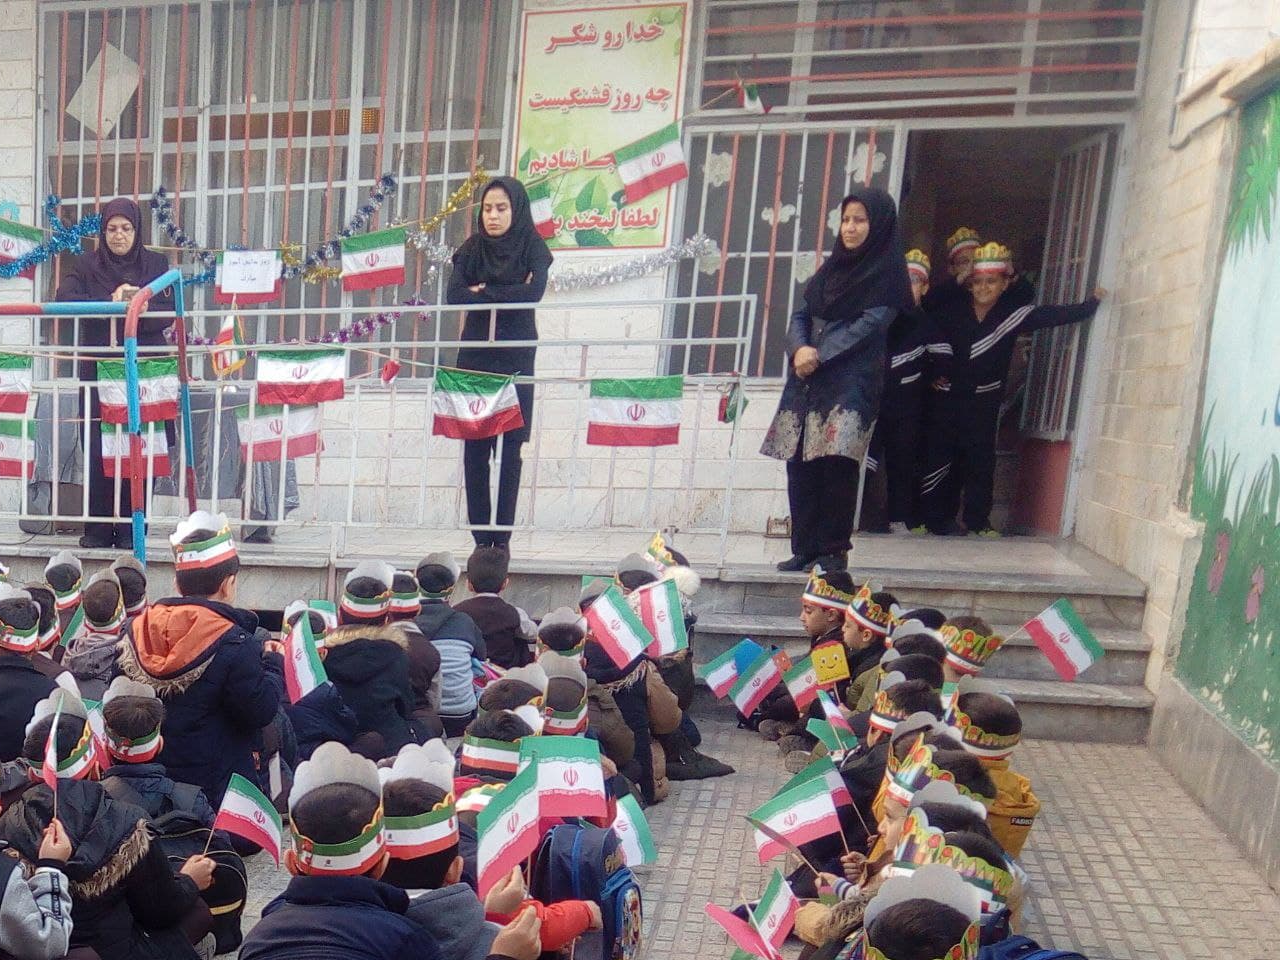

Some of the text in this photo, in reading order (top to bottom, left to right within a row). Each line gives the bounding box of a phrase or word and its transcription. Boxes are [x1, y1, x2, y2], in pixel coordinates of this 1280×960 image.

[543, 23, 598, 52] شکر
[626, 17, 664, 41] خدا
[528, 83, 671, 113] چه روز قشنگیست
[566, 207, 618, 235] لبخند
[620, 207, 659, 228] لطفا
